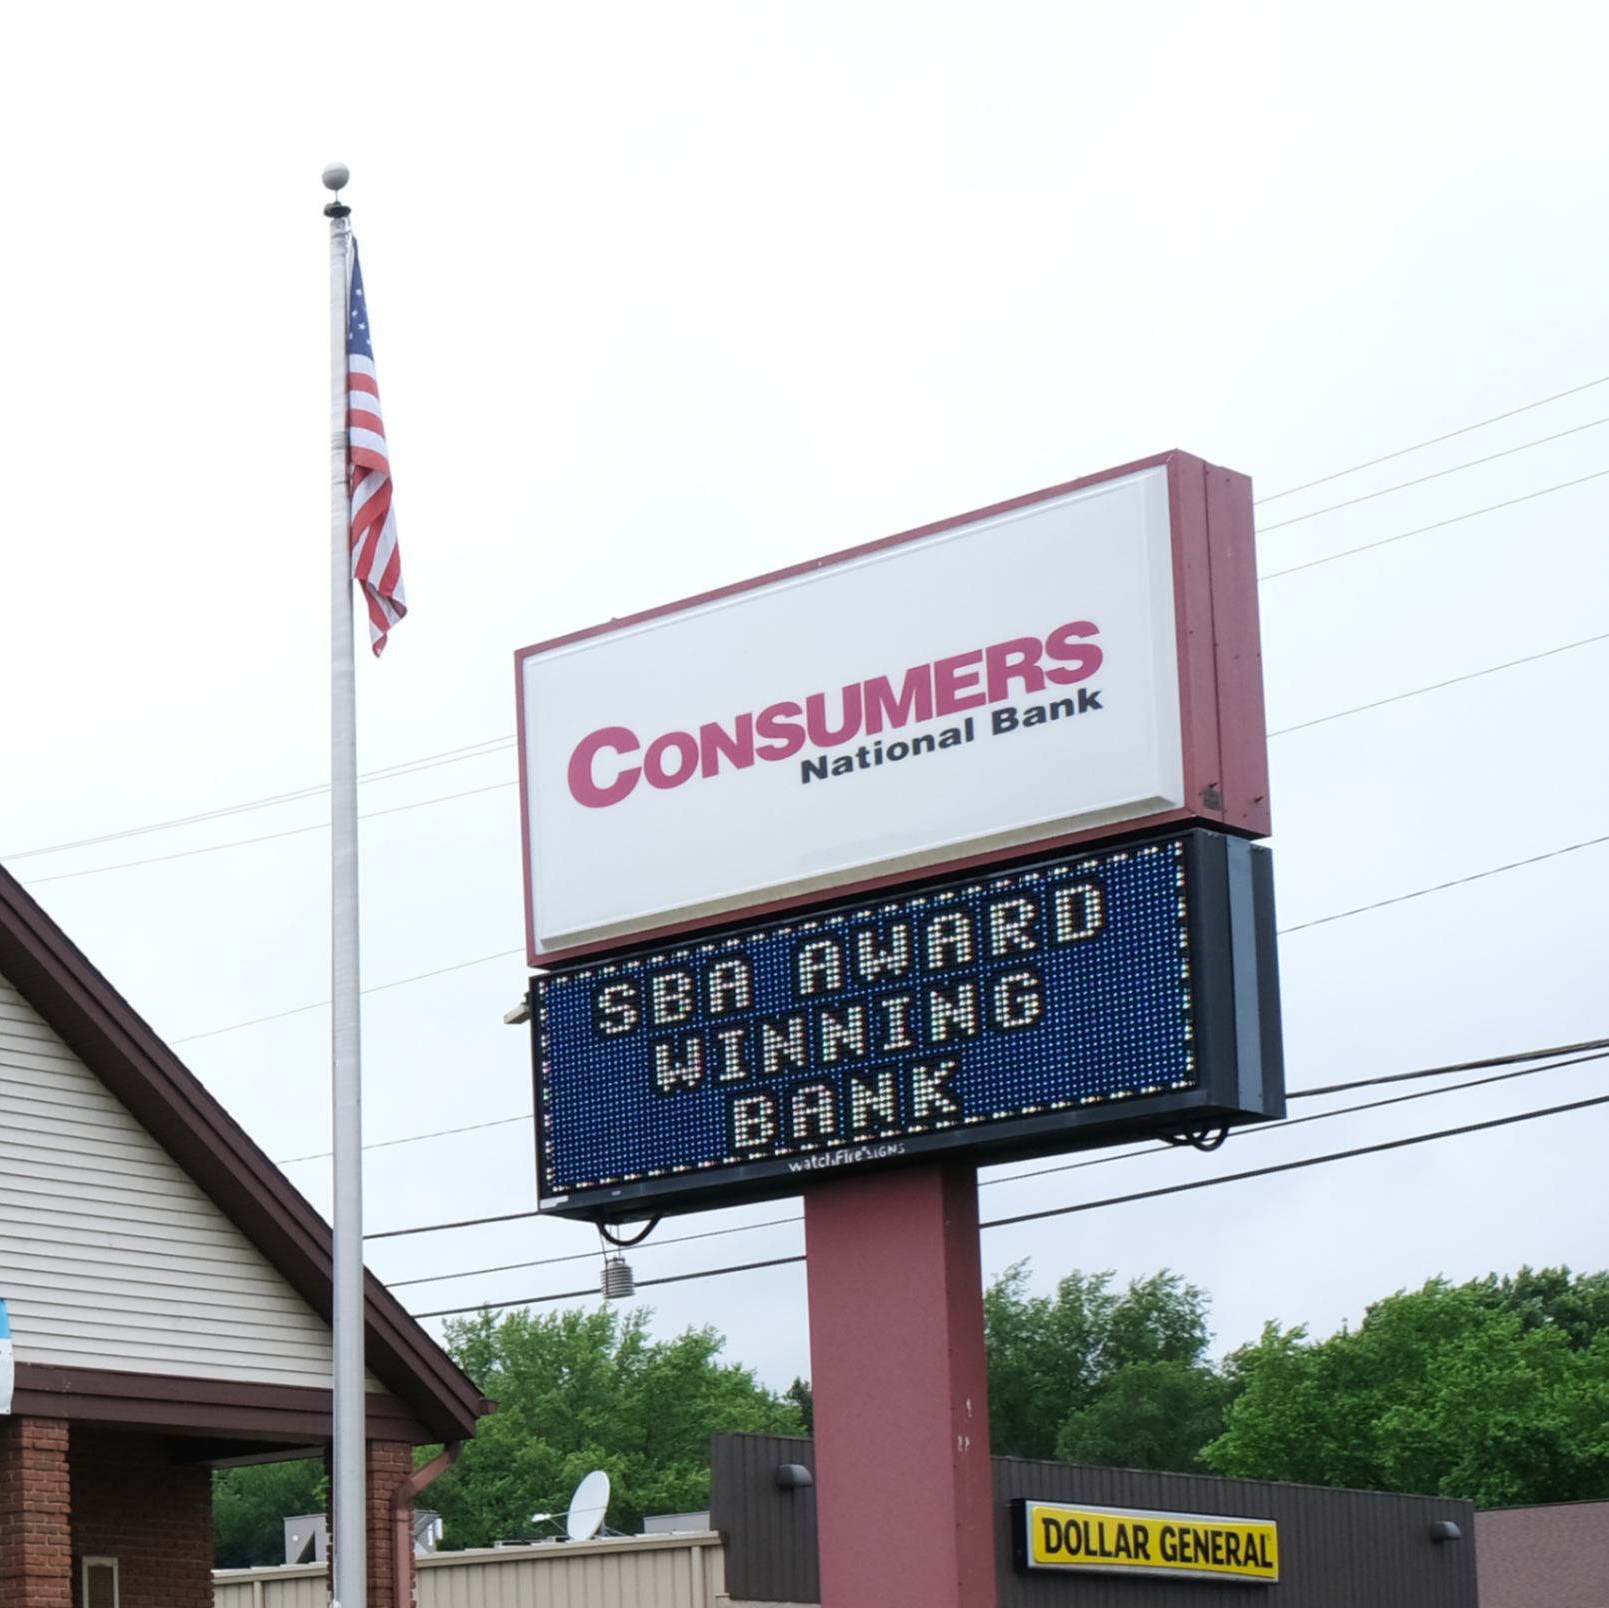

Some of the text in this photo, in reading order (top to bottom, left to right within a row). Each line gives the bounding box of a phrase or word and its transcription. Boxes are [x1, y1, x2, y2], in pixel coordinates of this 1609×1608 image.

[568, 620, 1104, 809] CONSUMERS
[800, 685, 1104, 784] National Bank
[598, 883, 1103, 1035] SBA AWARD
[655, 972, 1042, 1093] WINNING
[734, 1061, 960, 1150] BANK
[1041, 1517, 1273, 1569] DOLLAR GENERAL
